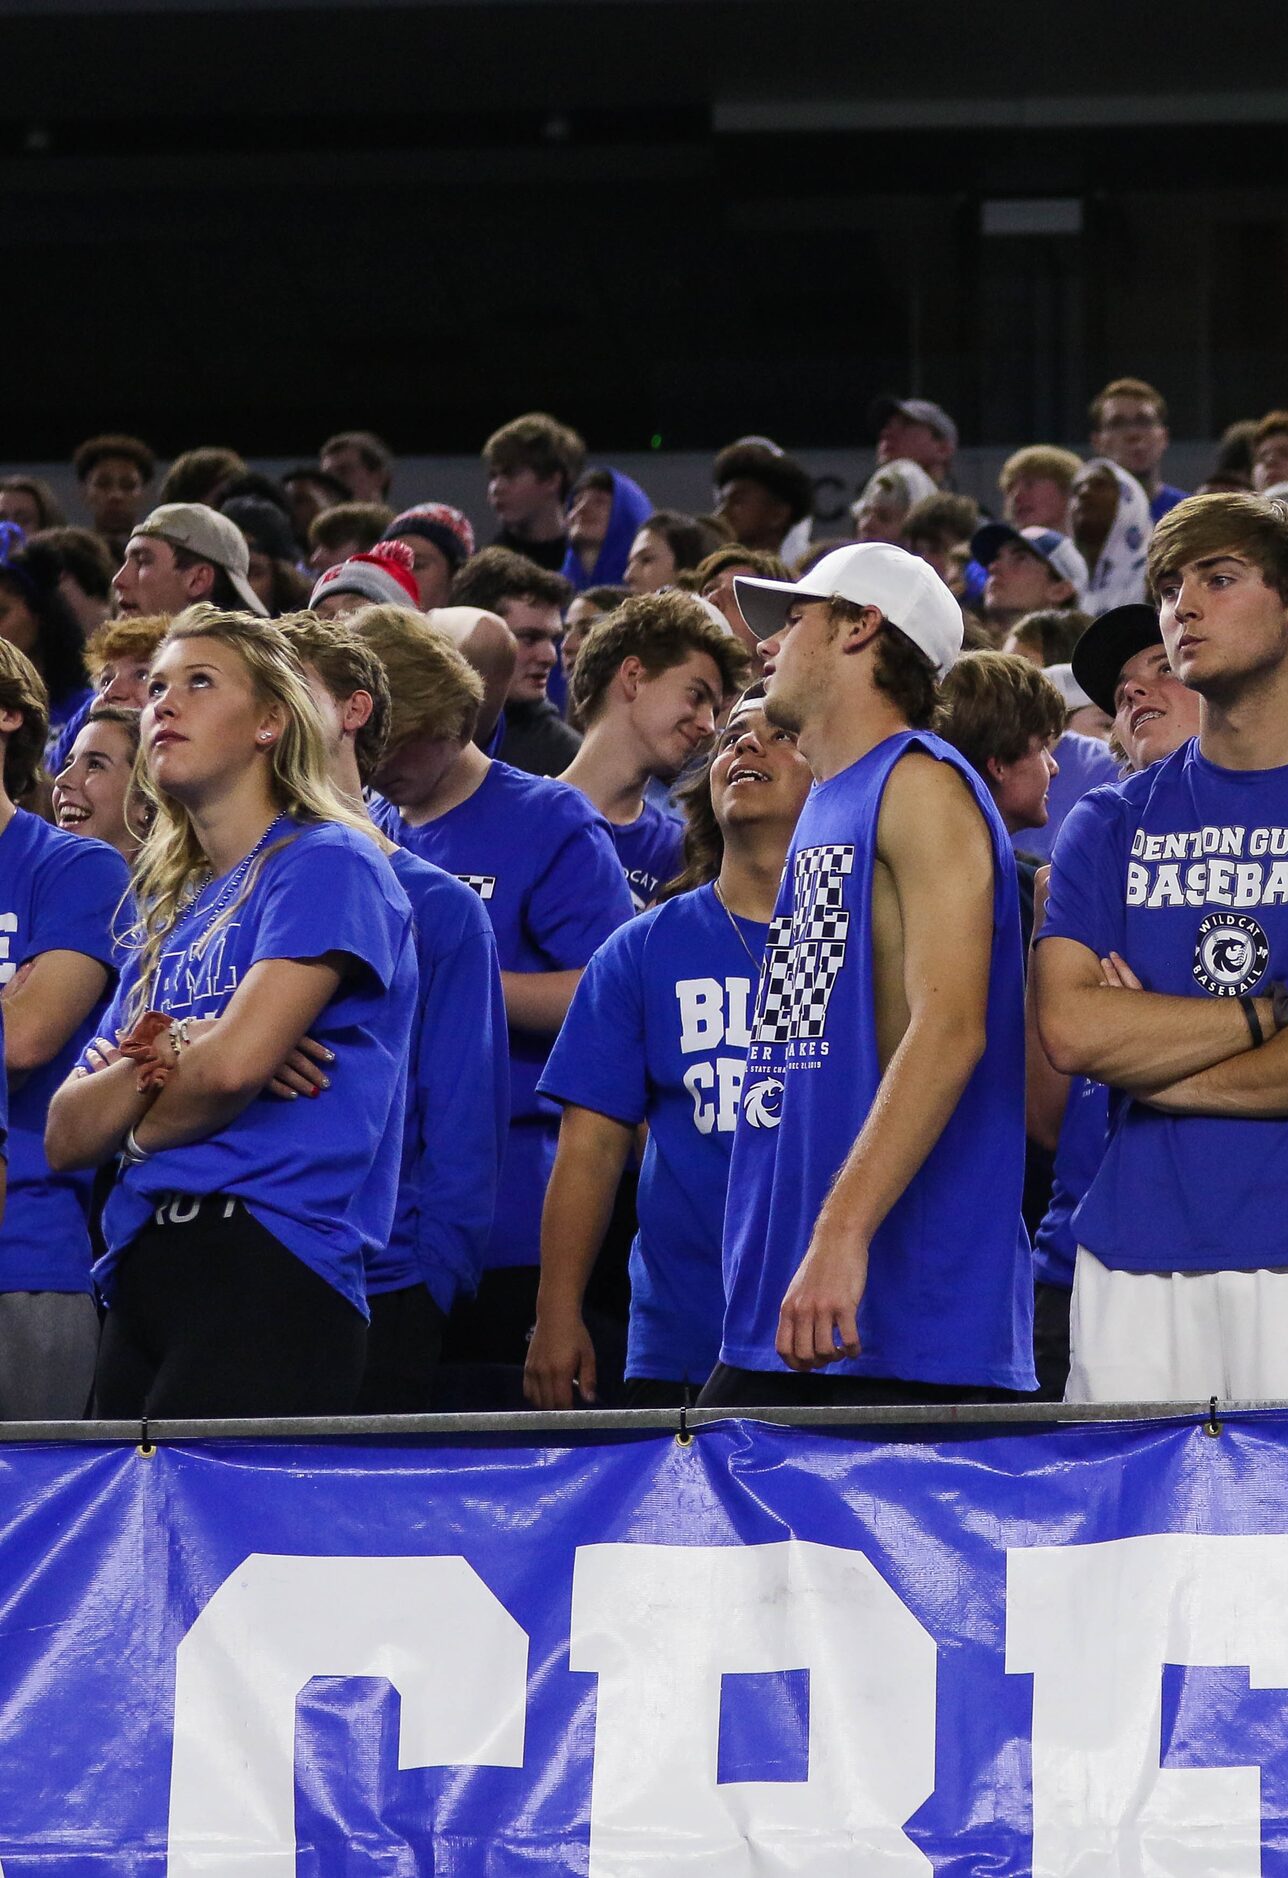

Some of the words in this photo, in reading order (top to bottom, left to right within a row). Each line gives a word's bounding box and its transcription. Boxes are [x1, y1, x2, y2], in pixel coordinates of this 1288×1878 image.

[1130, 826, 1245, 861] DENTON
[1198, 914, 1261, 937] WILDCAT
[1193, 964, 1263, 997] BASEBALL
[676, 977, 752, 1054] BL
[773, 1066, 787, 1074] CHA
